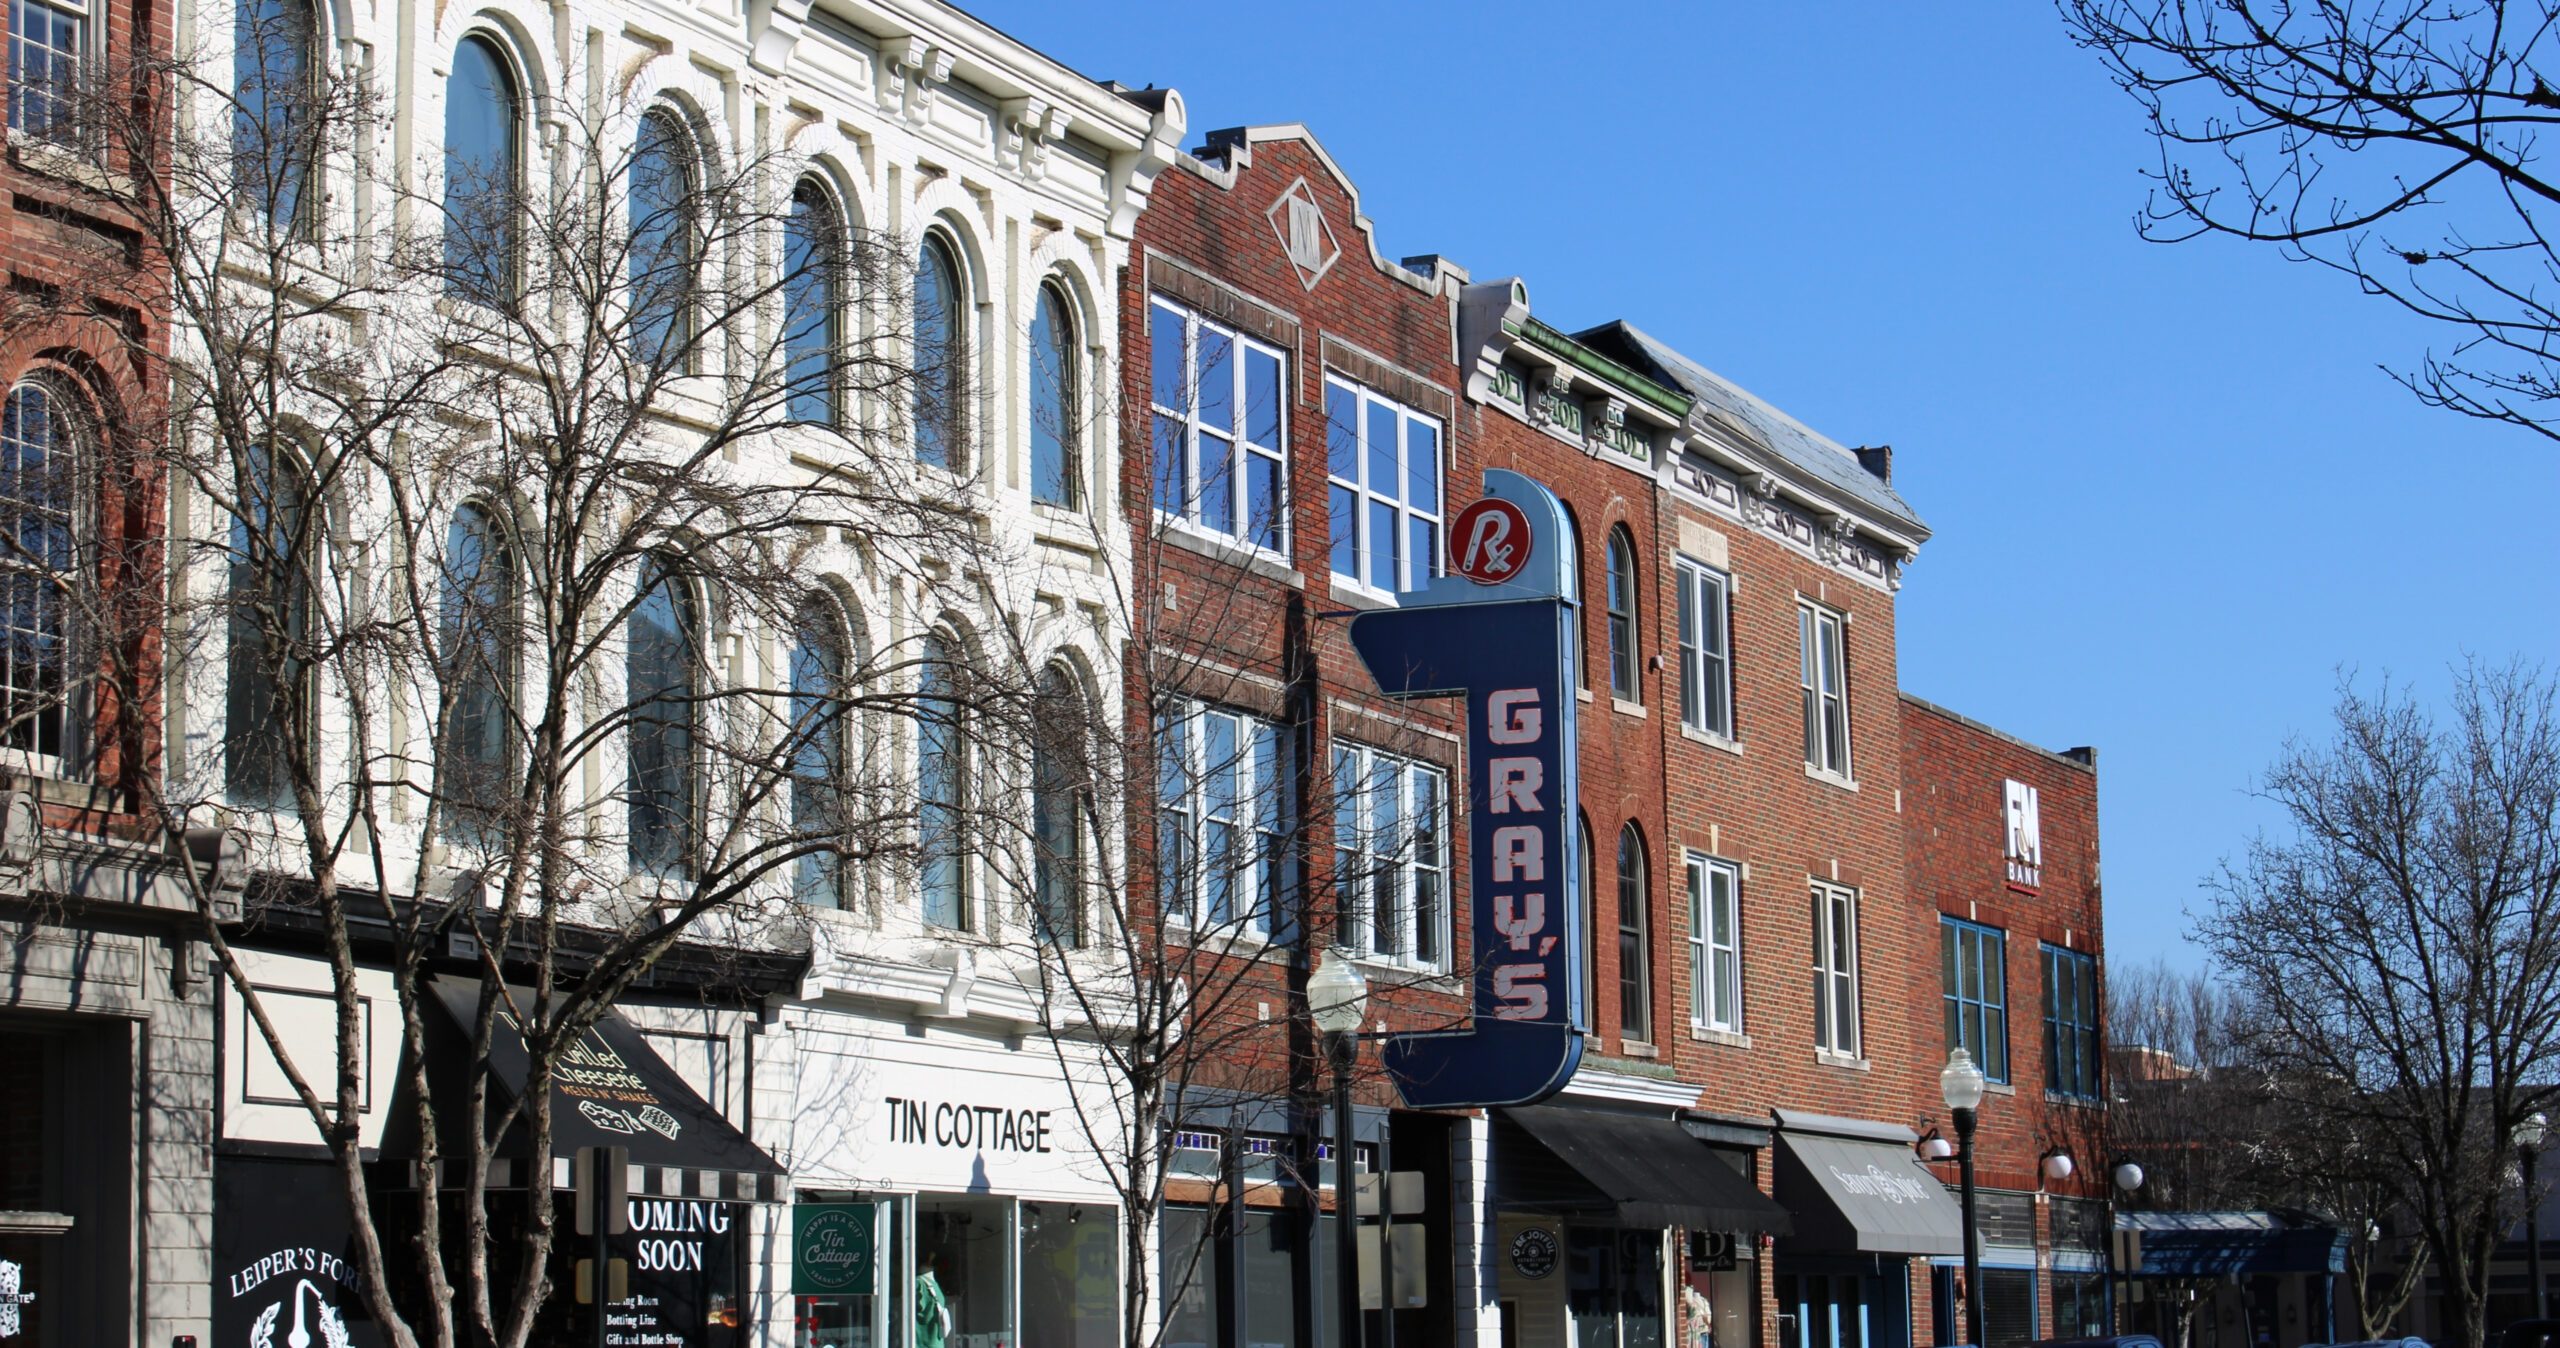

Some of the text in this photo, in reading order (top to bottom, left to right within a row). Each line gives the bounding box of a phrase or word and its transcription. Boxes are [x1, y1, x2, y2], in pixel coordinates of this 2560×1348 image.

[1488, 688, 1558, 1021] GRAY'S
[2007, 861, 2041, 888] BANK
[560, 1085, 600, 1098] MELTS
[612, 1090, 660, 1104] SHAKES
[885, 1096, 1051, 1153] TIN COTTAGE
[1829, 1165, 1931, 1204] Savory Spice
[627, 1201, 730, 1234] OMING
[804, 1214, 864, 1238] HAPPY IS A GIFT
[821, 1229, 846, 1248] Tin
[1527, 1231, 1555, 1255] JOYFUL
[638, 1239, 703, 1272] SOON
[805, 1243, 861, 1269] Cottage
[230, 1247, 316, 1298] LEIPER'S
[637, 1294, 659, 1306] Room
[606, 1313, 657, 1329] Bottling Line
[606, 1333, 684, 1348] Gift and Bottle Shop
